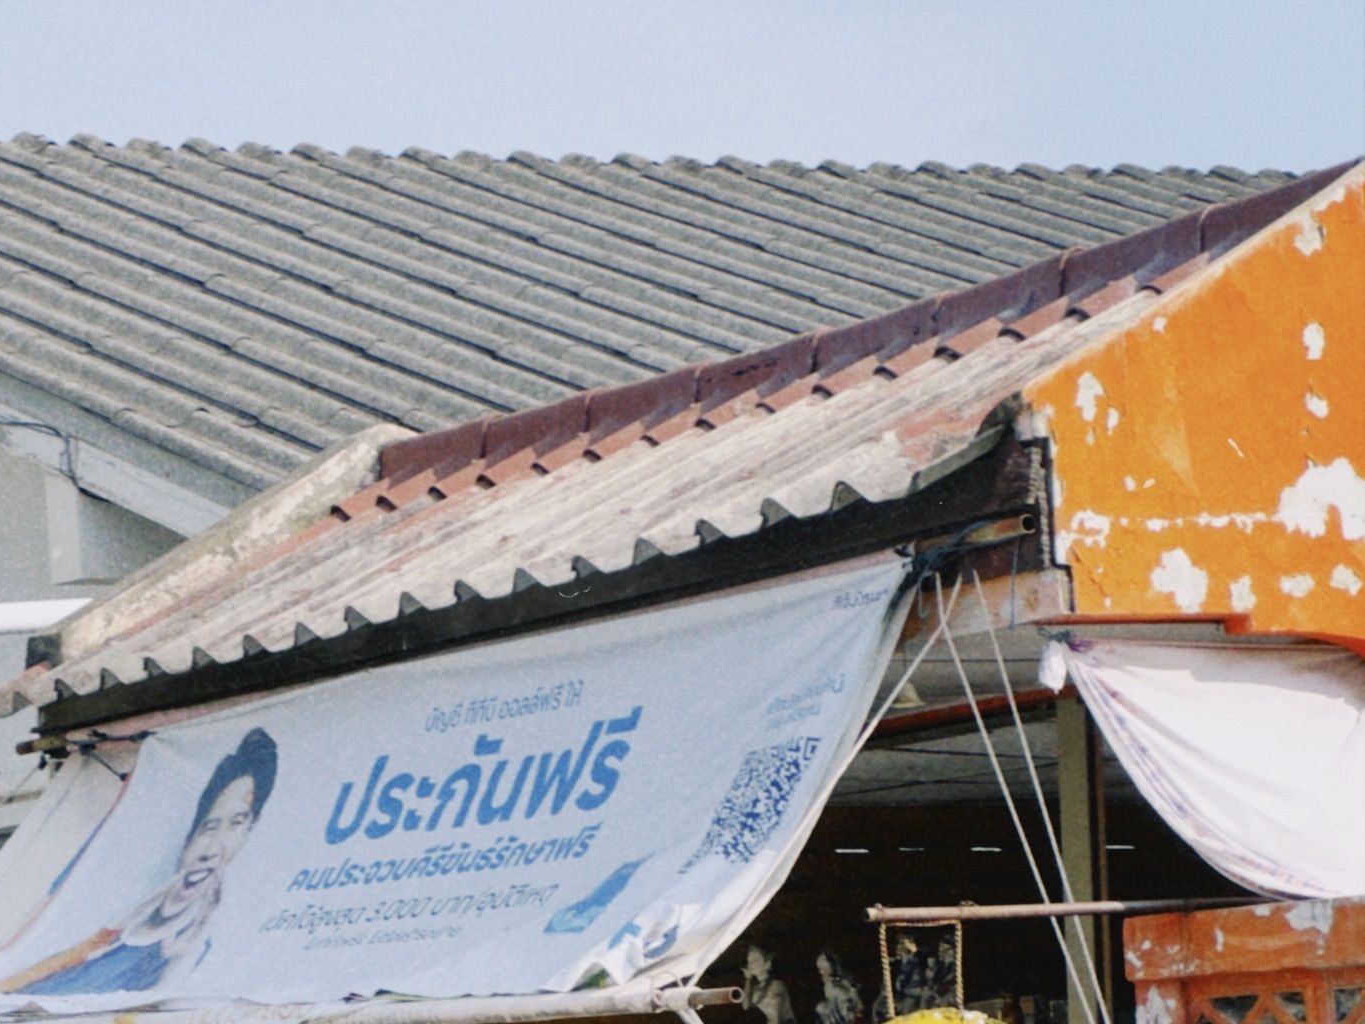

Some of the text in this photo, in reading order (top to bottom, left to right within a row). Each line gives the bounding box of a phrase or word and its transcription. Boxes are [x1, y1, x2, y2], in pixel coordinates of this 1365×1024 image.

[325, 705, 643, 845] ประกันฟรี
[287, 821, 603, 893] คนประจวบคีรีขันธ์รักษาฟรี
